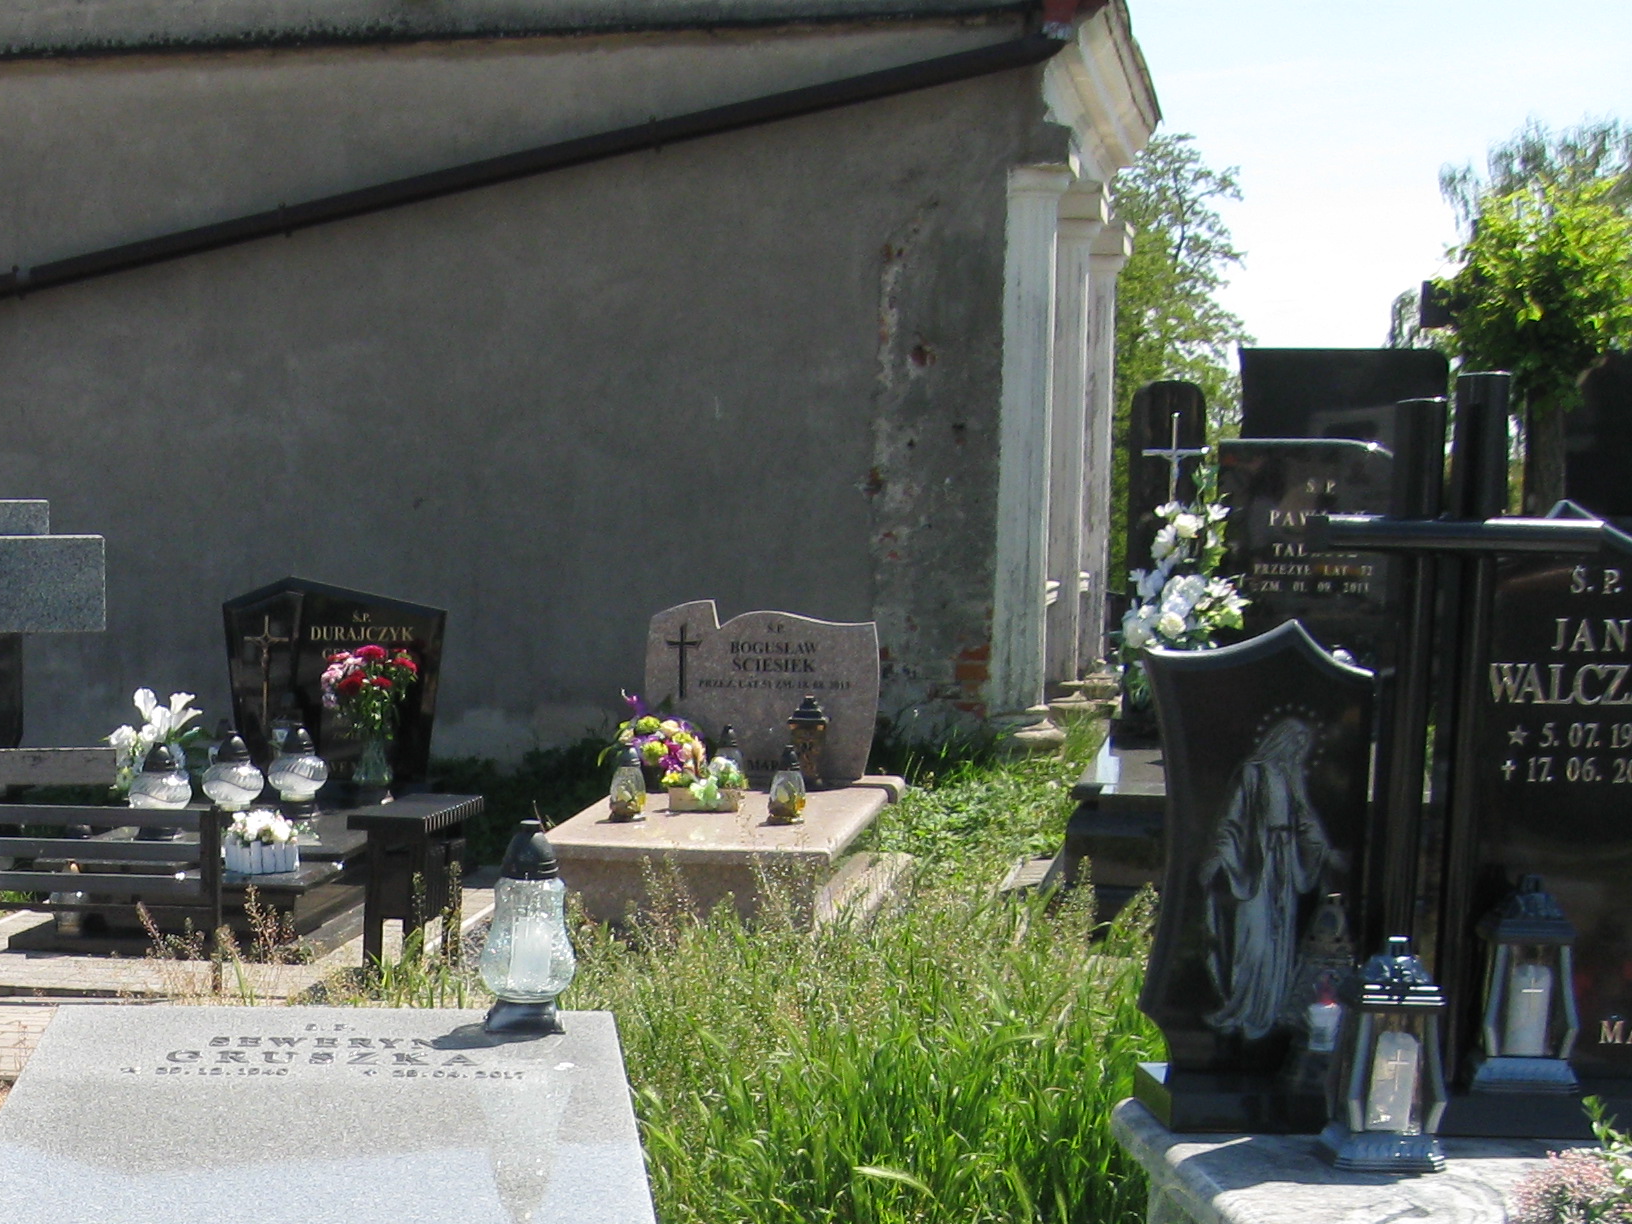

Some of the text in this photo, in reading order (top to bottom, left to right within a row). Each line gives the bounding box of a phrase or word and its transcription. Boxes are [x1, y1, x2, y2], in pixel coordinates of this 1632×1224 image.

[311, 626, 414, 640] DURAJCZYK
[1551, 618, 1632, 652] JAN
[1489, 663, 1632, 705] WALCZ
[1610, 723, 1632, 748] 19
[166, 1050, 480, 1066] GRUSZKA
